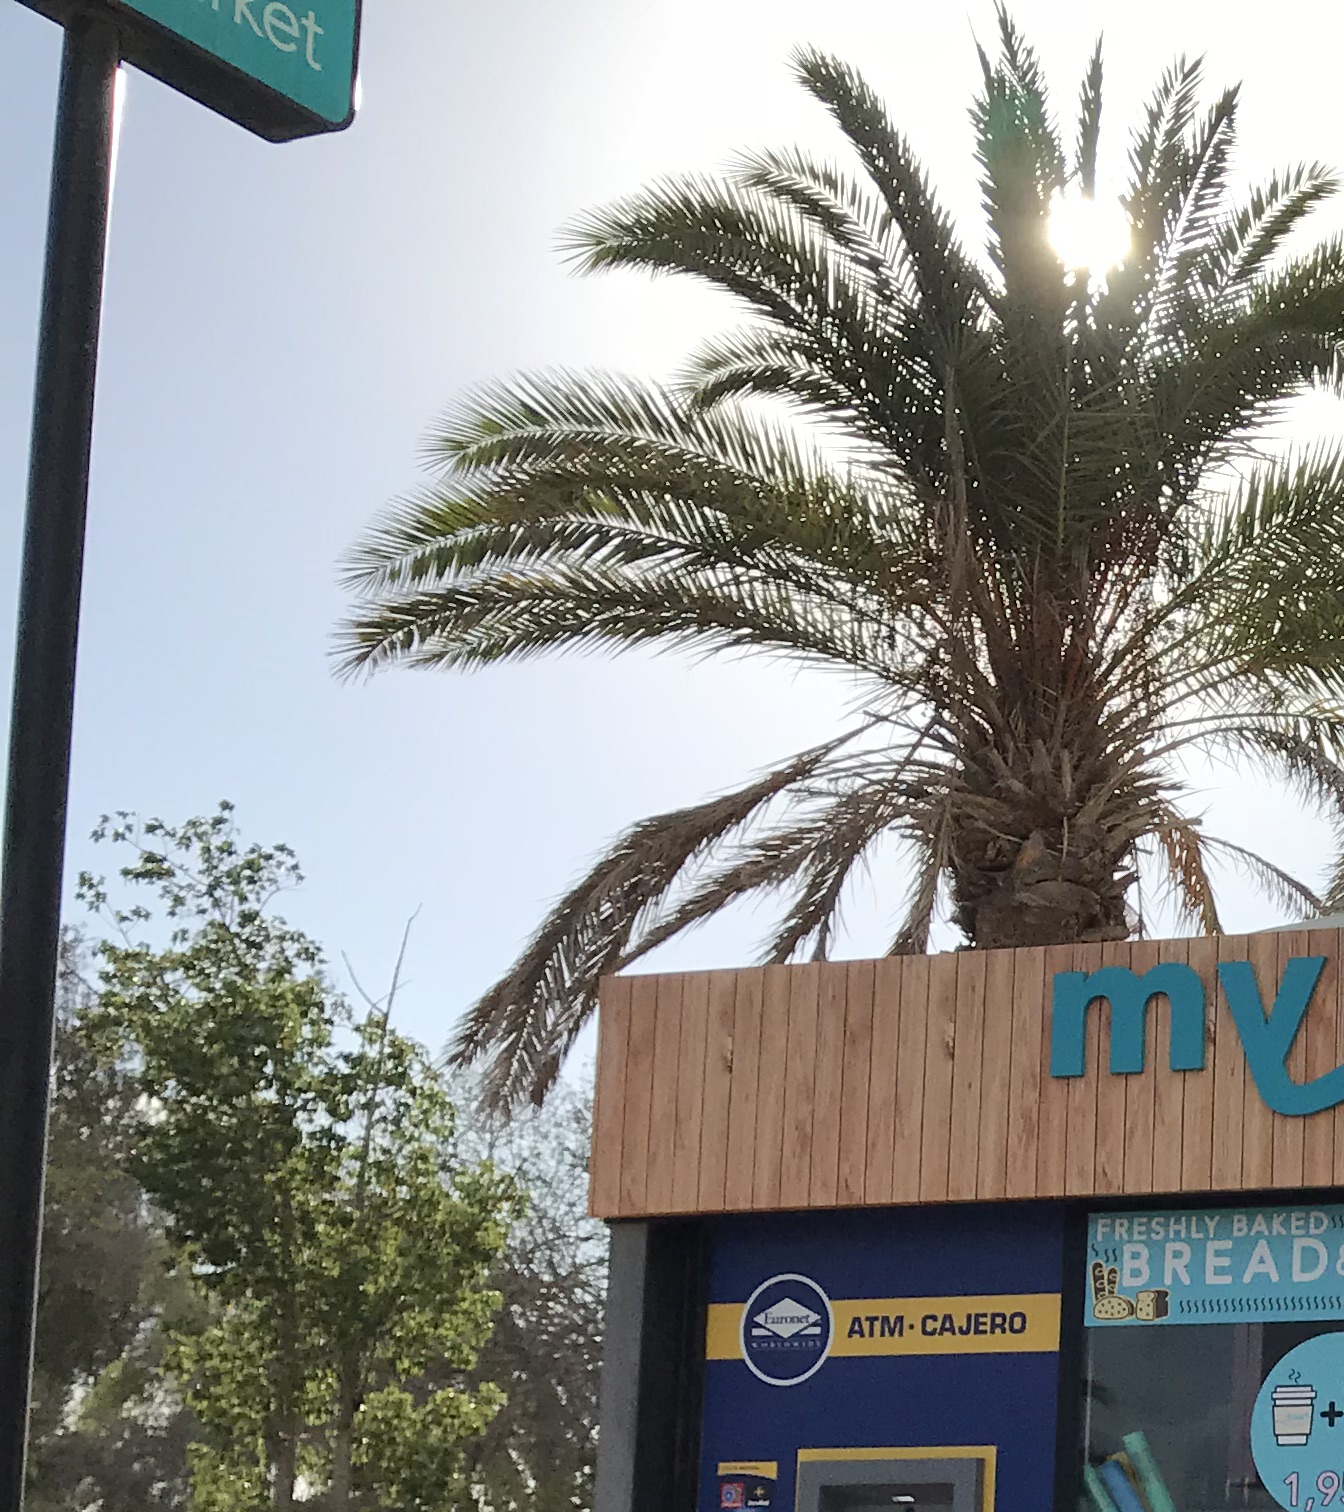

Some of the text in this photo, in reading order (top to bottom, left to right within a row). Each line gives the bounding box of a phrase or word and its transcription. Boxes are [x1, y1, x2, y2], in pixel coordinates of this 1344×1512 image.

[1050, 955, 1328, 1117] my
[1096, 1210, 1329, 1242] FRESHLY BAKED
[847, 1311, 1028, 1338] ATM CAJERO
